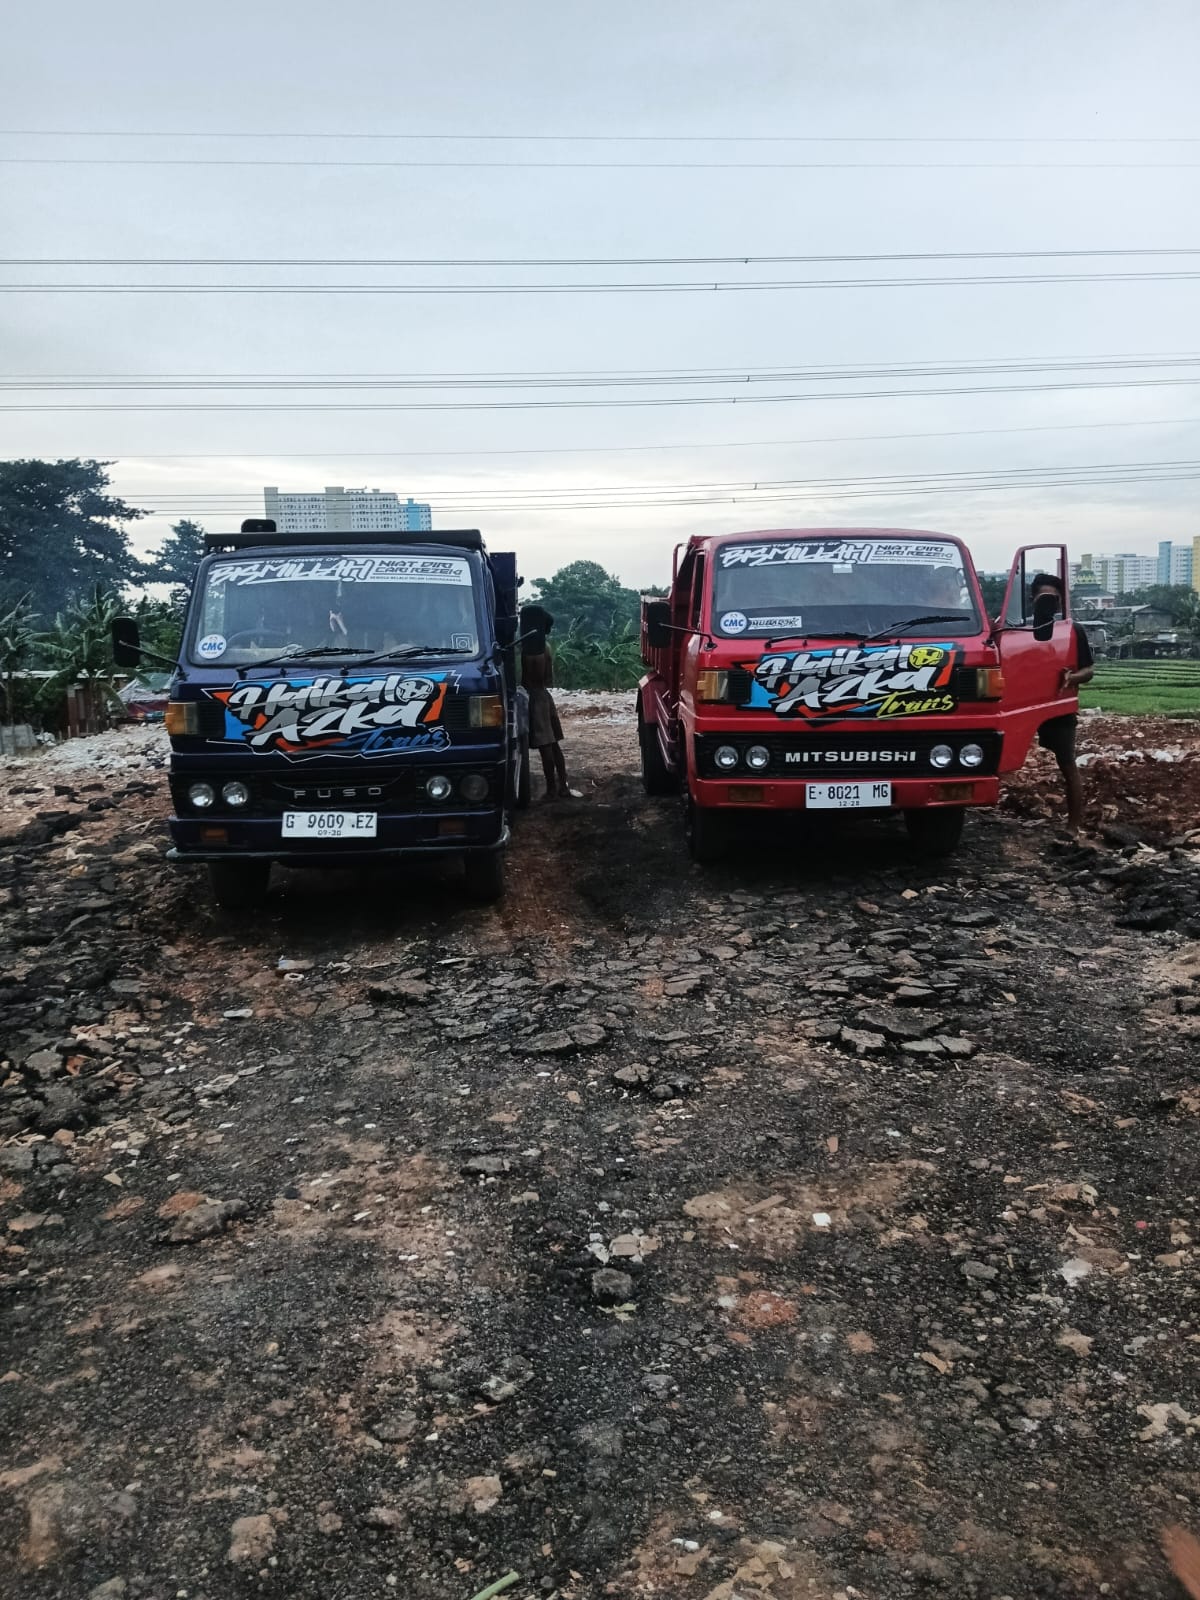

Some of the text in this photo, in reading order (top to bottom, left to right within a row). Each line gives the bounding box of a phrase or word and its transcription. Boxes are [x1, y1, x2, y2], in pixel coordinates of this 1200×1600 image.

[906, 550, 954, 559] REZEKI
[915, 545, 945, 553] DIRI
[719, 543, 874, 568] BISMILLAH
[378, 560, 454, 569] NIAT DIRI
[207, 558, 374, 586] BISMILLAH
[411, 567, 463, 576] REZEKI
[723, 619, 744, 627] CMC
[201, 642, 224, 651] CMC
[865, 690, 954, 719] Trans
[347, 724, 448, 755] Trans
[785, 751, 917, 763] MITSUBISHI
[294, 787, 382, 799] FUSO
[808, 784, 889, 800] E 8021 MG
[285, 814, 295, 829] G
[307, 814, 345, 829] 9609
